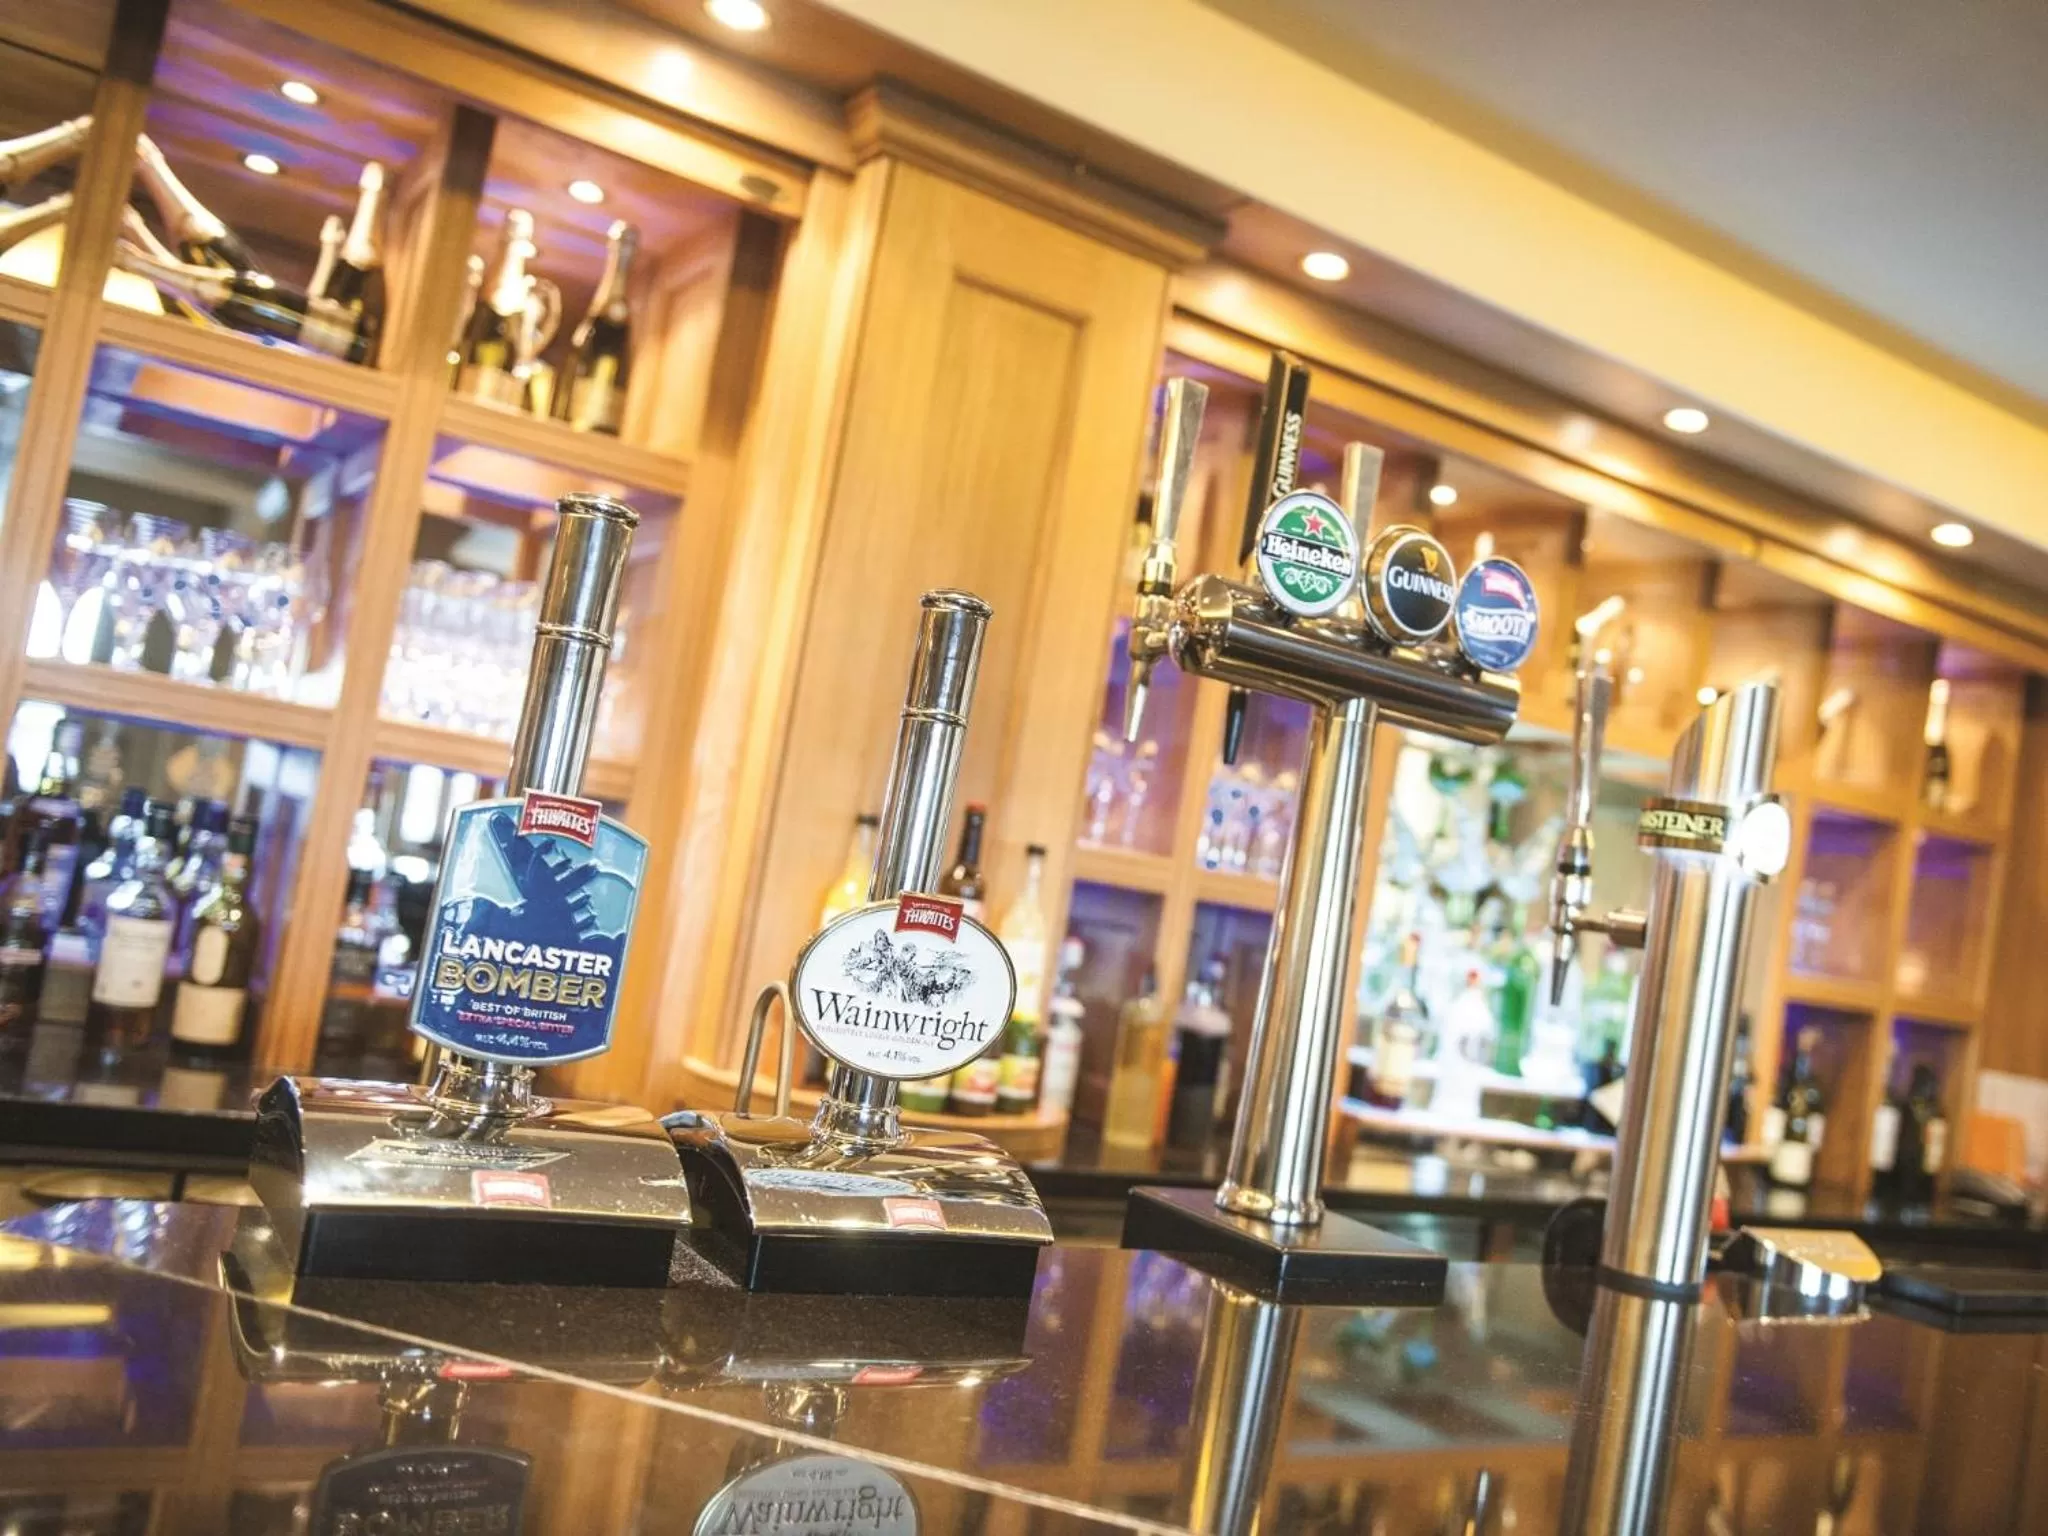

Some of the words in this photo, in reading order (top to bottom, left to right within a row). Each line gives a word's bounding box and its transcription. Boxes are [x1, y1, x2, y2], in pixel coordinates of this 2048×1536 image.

[1273, 410, 1302, 498] GUINNESS
[442, 930, 613, 977] LANCASTER
[435, 957, 608, 1008] BOMBER
[472, 1000, 501, 1013] BEST
[504, 1004, 521, 1016] OF
[523, 1007, 567, 1021] BRITISH
[810, 988, 989, 1050] Wainwright
